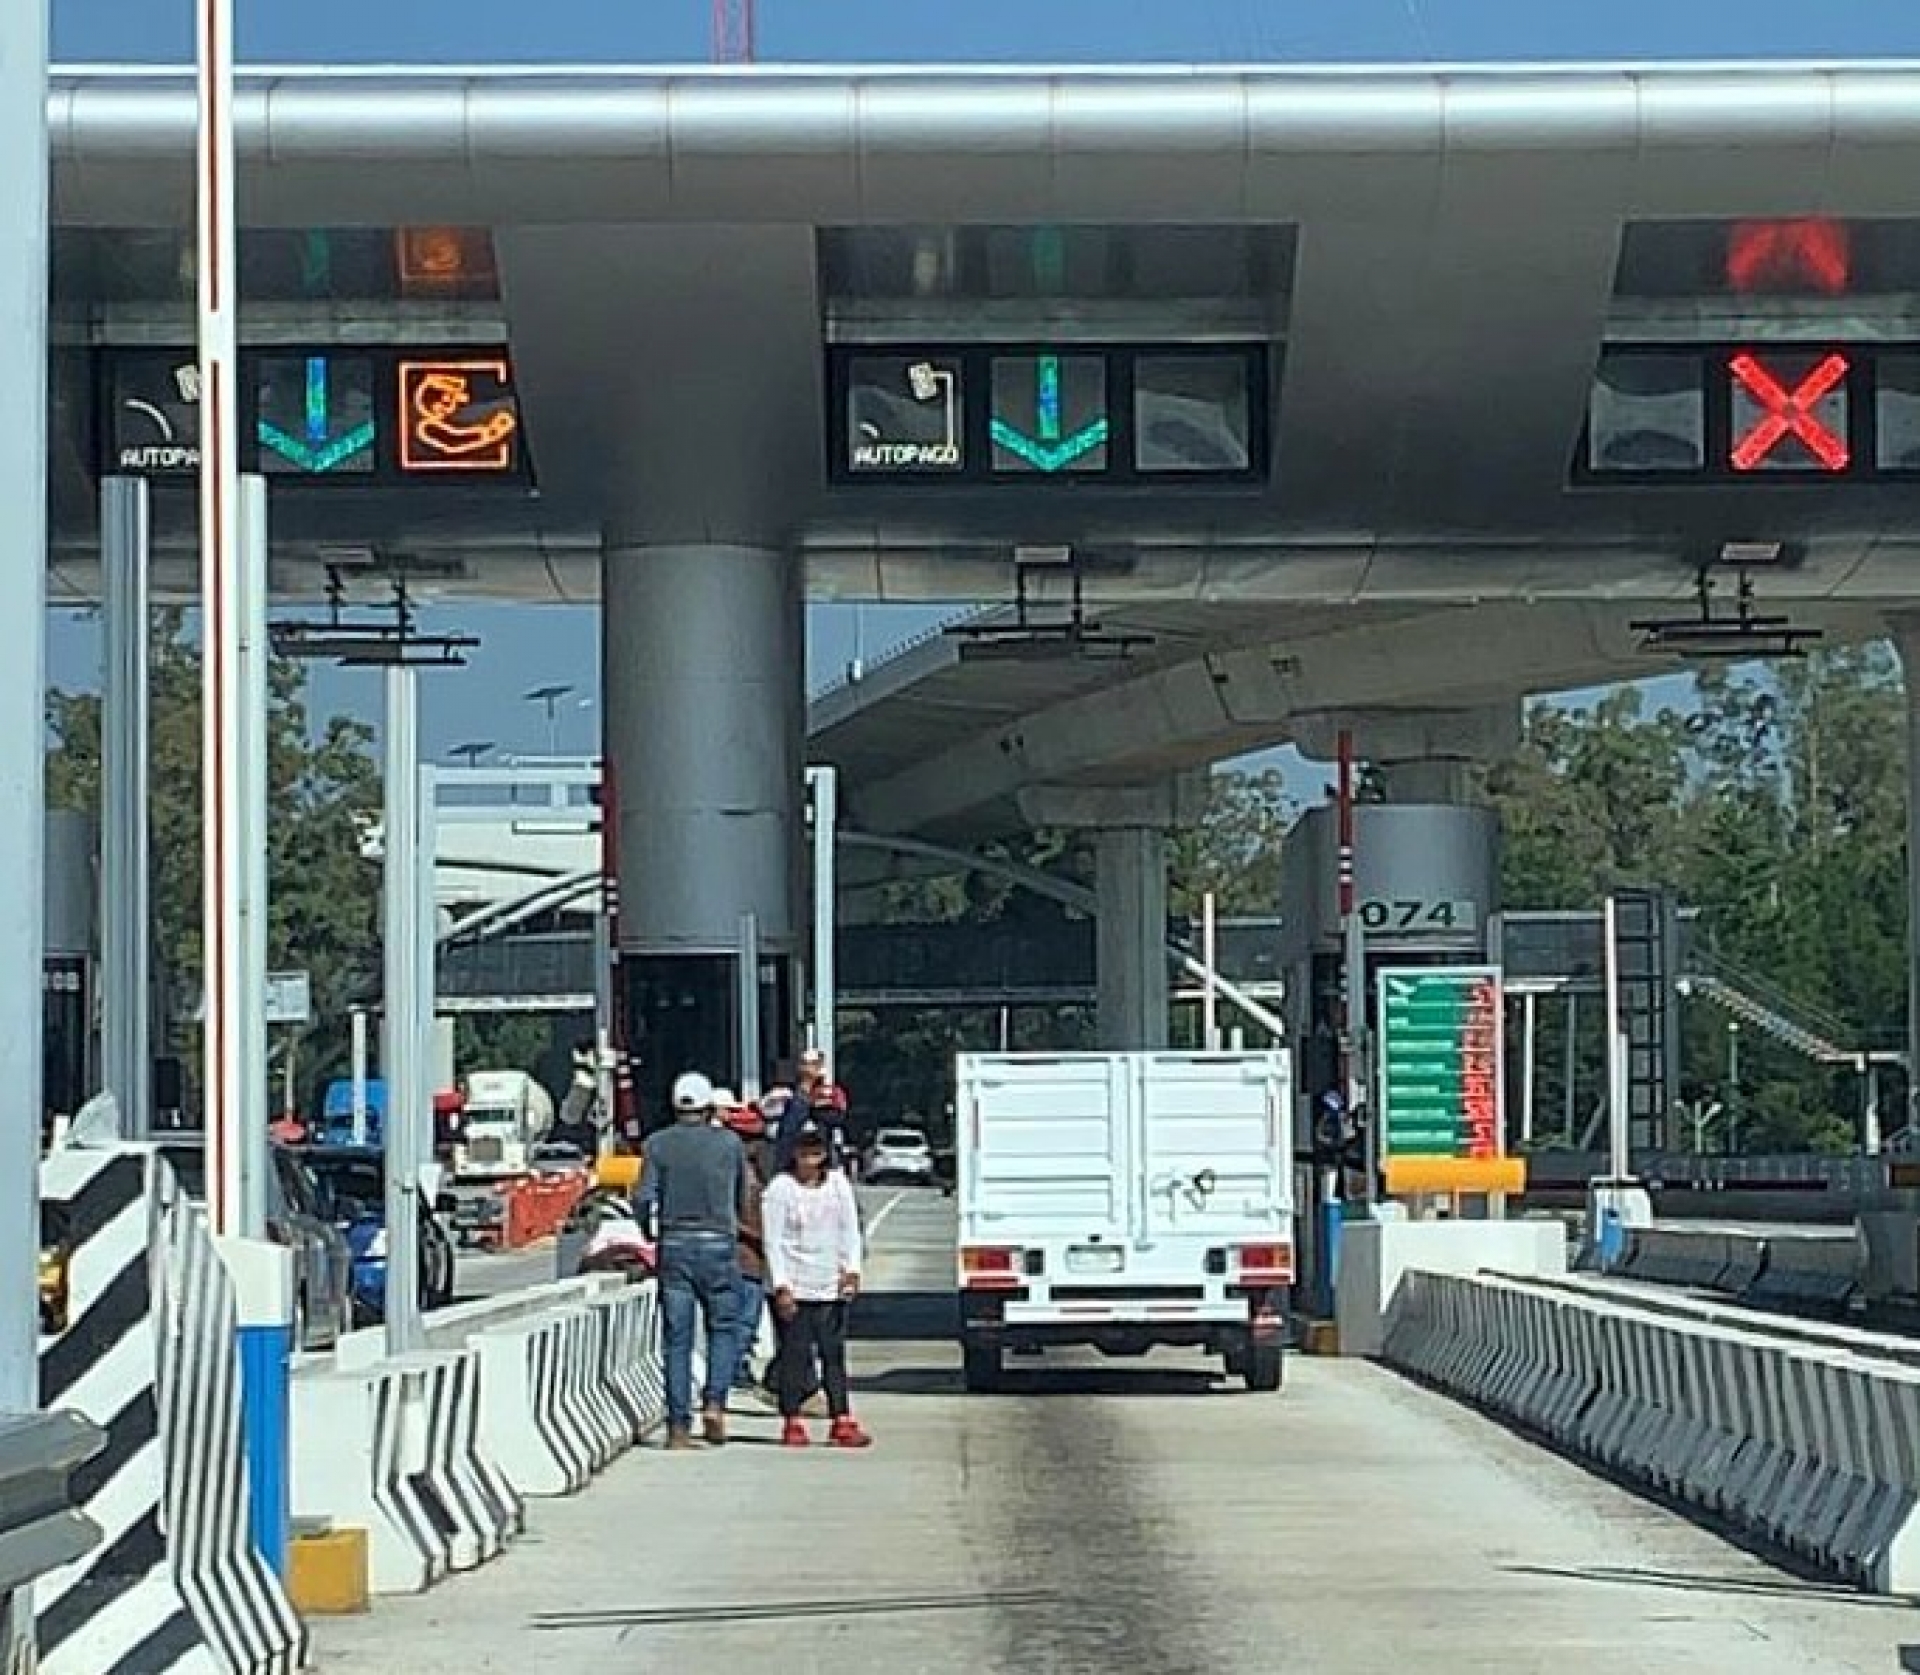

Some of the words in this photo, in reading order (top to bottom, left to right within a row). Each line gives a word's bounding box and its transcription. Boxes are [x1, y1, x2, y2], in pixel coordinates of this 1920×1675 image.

[120, 447, 201, 467] AUTOPA
[854, 444, 958, 464] AUTOPAGO
[1359, 901, 1456, 927] 074
